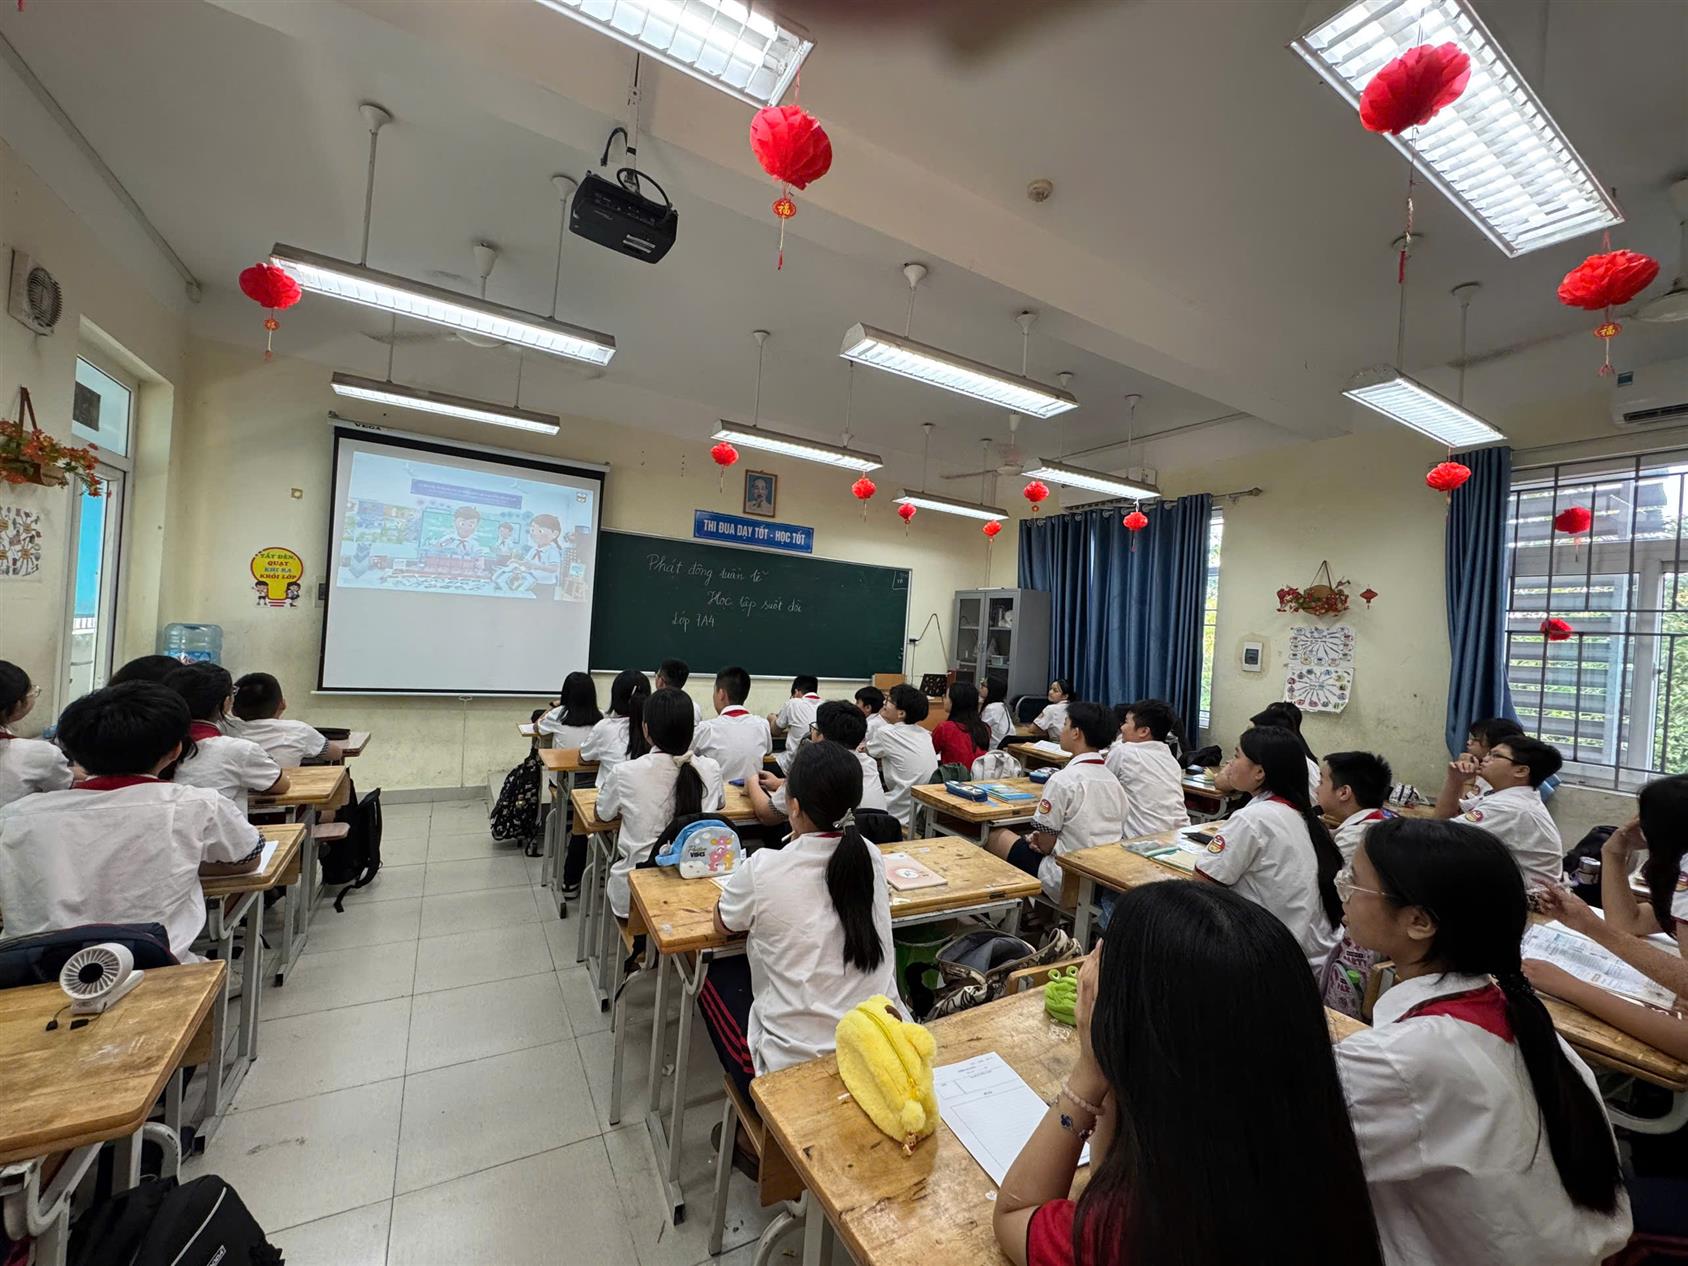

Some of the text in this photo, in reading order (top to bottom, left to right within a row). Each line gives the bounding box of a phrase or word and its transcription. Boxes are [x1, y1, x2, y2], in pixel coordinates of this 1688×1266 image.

[703, 519, 717, 532] THI
[718, 521, 735, 535] ĐUA
[736, 524, 753, 540] DẠY
[754, 524, 769, 540] TỐT
[775, 530, 791, 544] HỌC
[792, 530, 806, 545] TỐT
